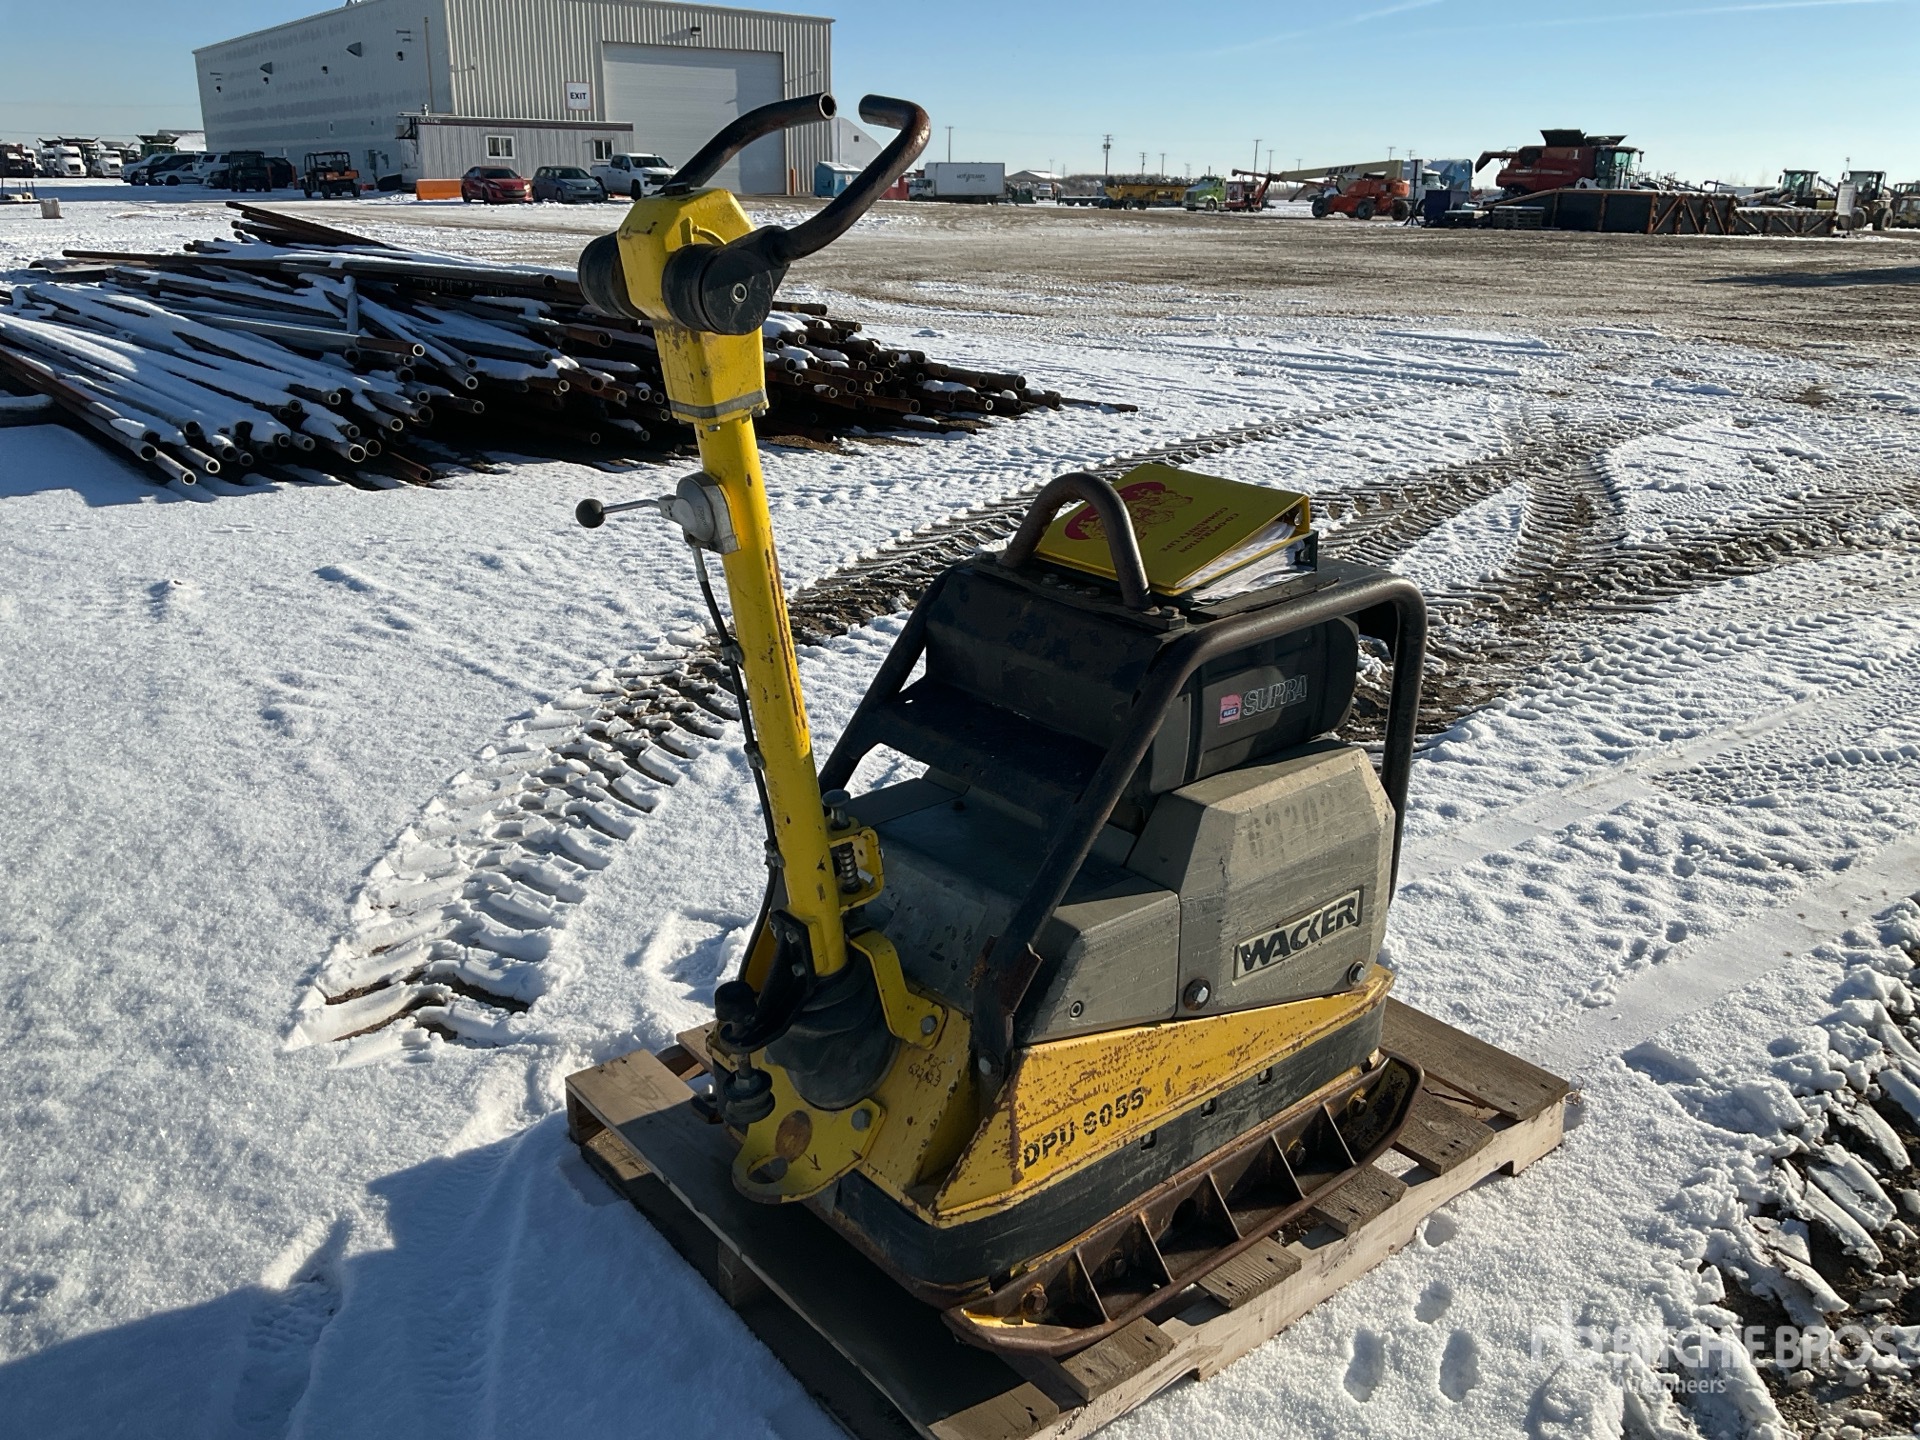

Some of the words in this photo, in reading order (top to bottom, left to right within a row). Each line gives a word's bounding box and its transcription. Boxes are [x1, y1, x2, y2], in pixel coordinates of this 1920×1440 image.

[570, 92, 587, 100] EXIT
[1179, 513, 1239, 553] CO-OPERATION
[1180, 507, 1228, 539] COMMUNITY
[1193, 526, 1211, 537] AND
[1160, 540, 1180, 552] LIFE
[1242, 675, 1307, 716] SUPRA
[1240, 897, 1357, 972] WACKER
[1024, 1121, 1075, 1169] DPU
[1083, 1087, 1144, 1135] 6055
